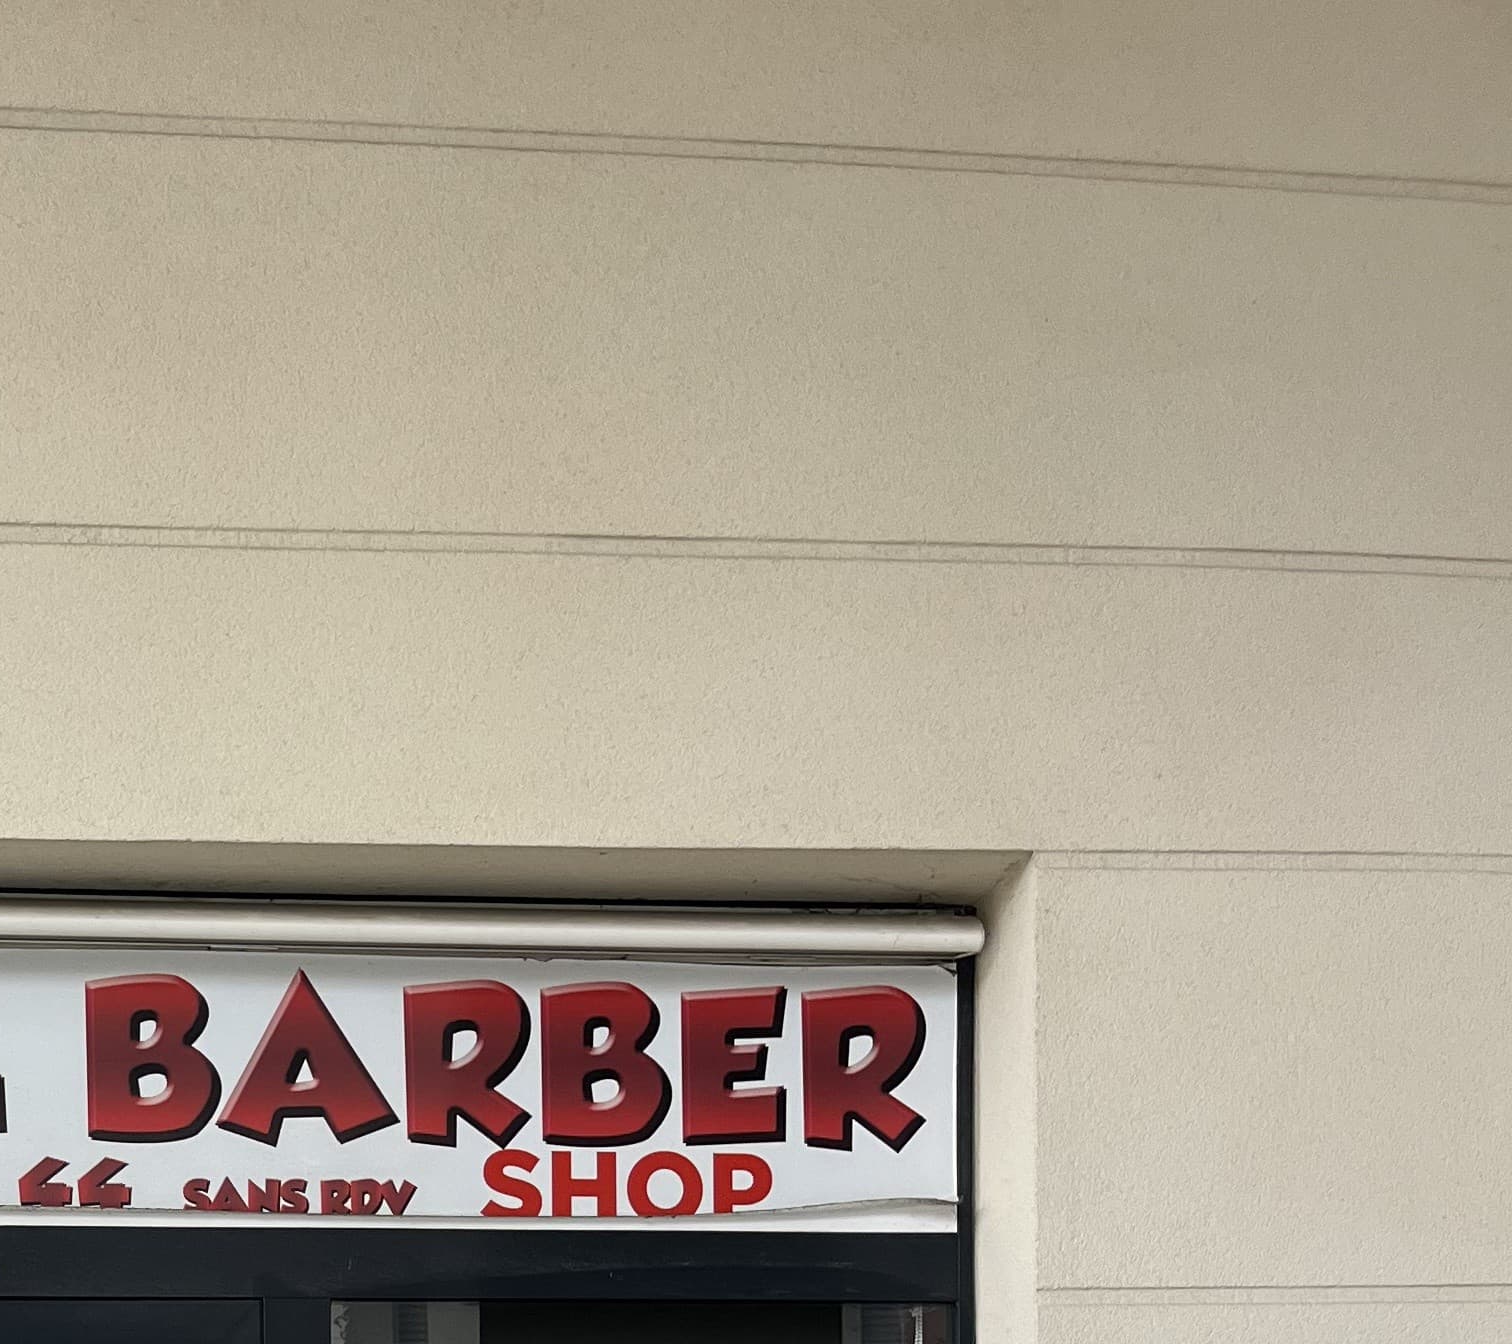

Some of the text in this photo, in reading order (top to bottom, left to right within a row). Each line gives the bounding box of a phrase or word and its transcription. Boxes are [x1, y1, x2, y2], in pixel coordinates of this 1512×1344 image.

[85, 968, 926, 1152] BARBER
[183, 1175, 309, 1215] SANS
[320, 1180, 419, 1215] RDV
[480, 1149, 773, 1217] SHOP
